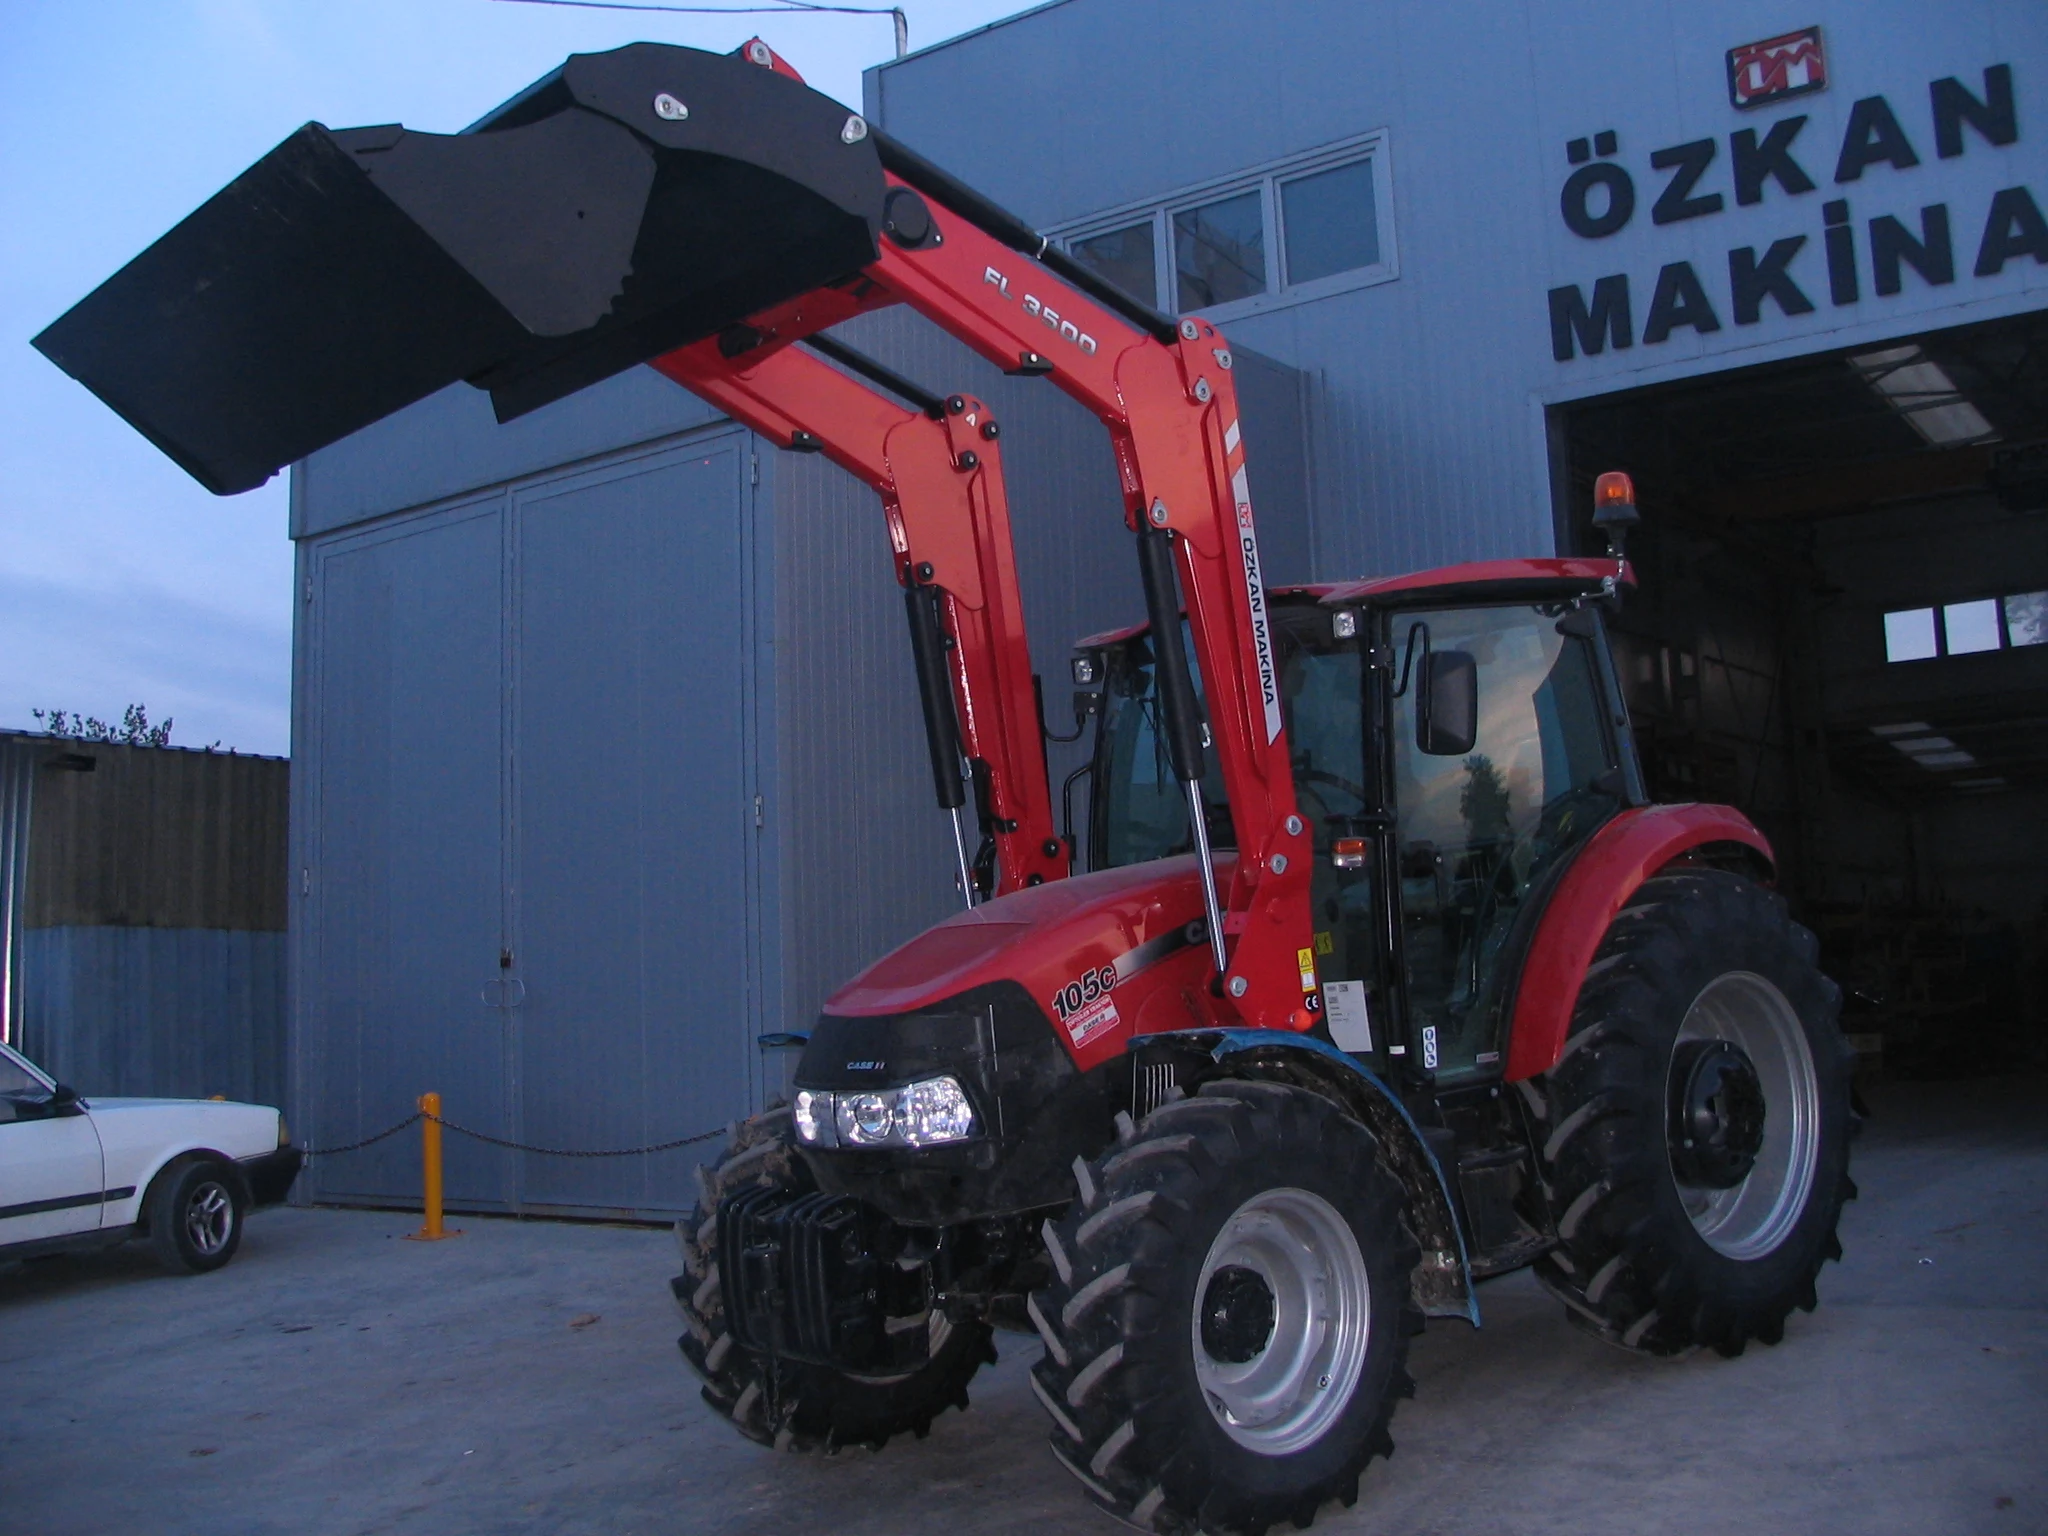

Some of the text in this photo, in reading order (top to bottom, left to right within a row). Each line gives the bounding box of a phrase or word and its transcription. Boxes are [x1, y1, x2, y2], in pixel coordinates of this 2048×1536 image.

[1561, 64, 2018, 239] ÖZKAN
[983, 266, 1098, 356] FL 3500
[1548, 186, 2048, 361] MAKİNA
[1243, 537, 1262, 613] ÖZKAN
[1255, 620, 1274, 705] MAKİNA
[847, 1061, 875, 1070] CASE
